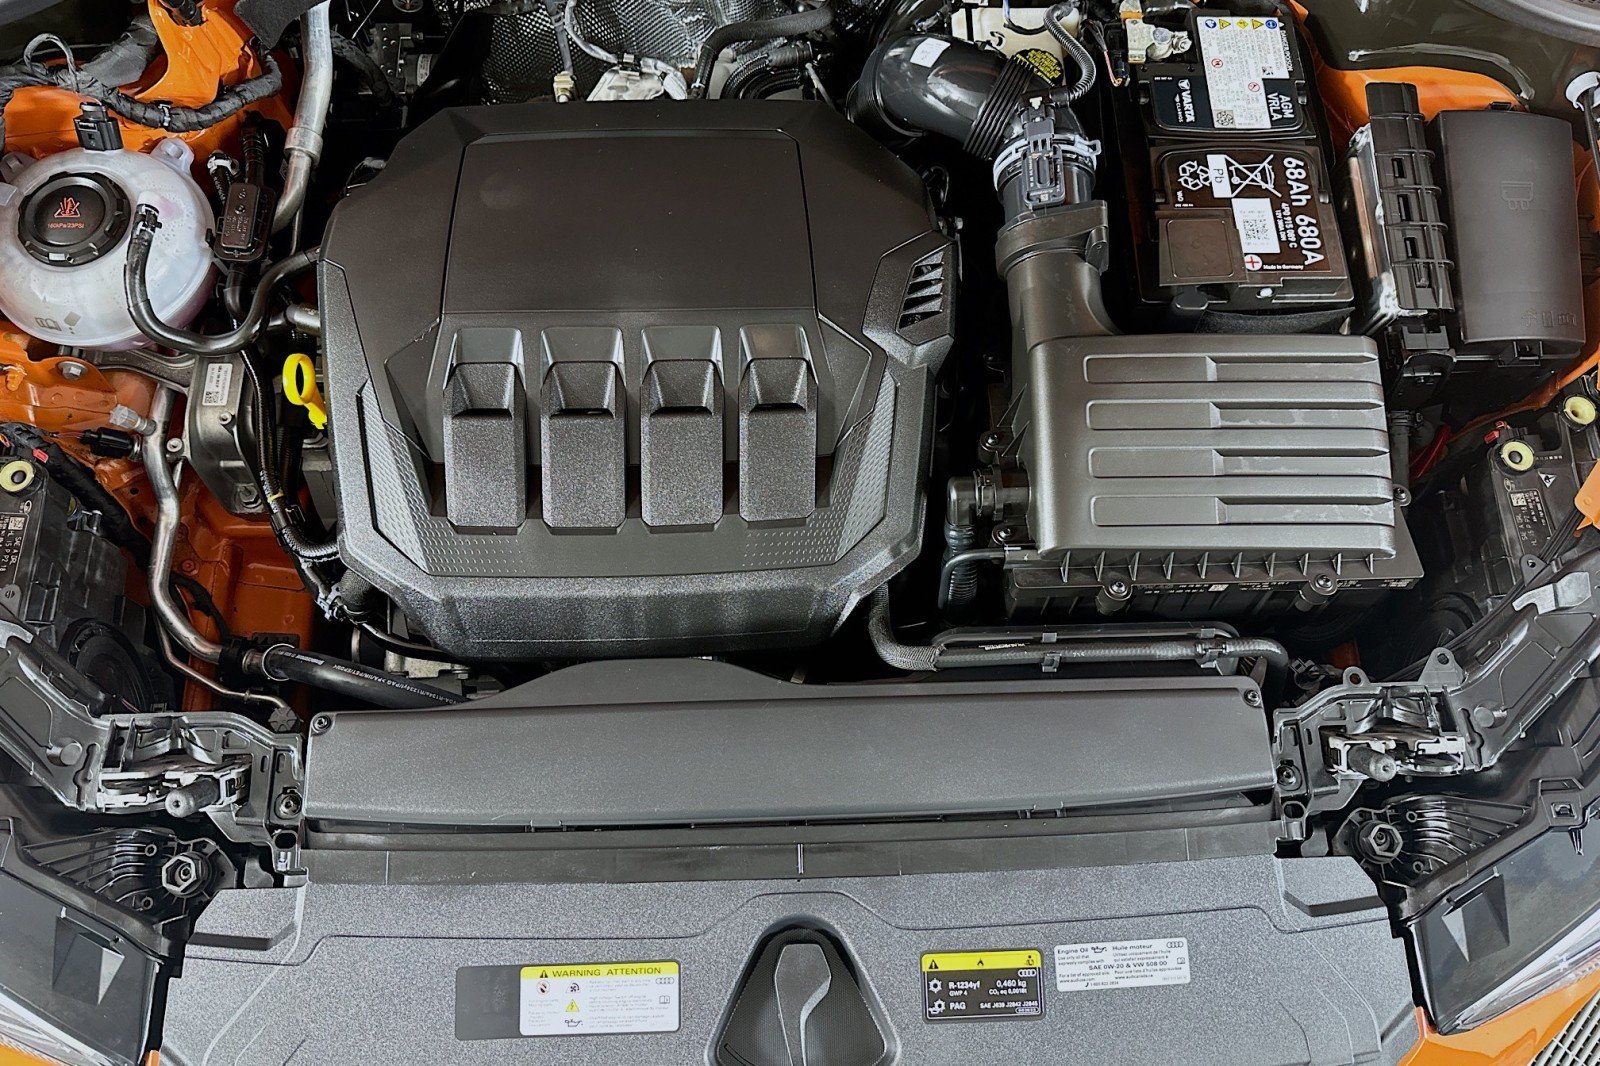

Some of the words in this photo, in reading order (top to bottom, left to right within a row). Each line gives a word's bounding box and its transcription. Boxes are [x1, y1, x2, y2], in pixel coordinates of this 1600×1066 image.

[1182, 90, 1195, 122] VARTA
[1267, 92, 1282, 121] VRLA
[1278, 94, 1294, 118] AGM
[1213, 168, 1225, 184] Pb
[1284, 157, 1312, 206] 68Ah
[1295, 214, 1324, 266] 680A
[607, 967, 661, 976] ATTENTION
[949, 981, 980, 990] R-1234yf
[1018, 980, 1026, 988] kg
